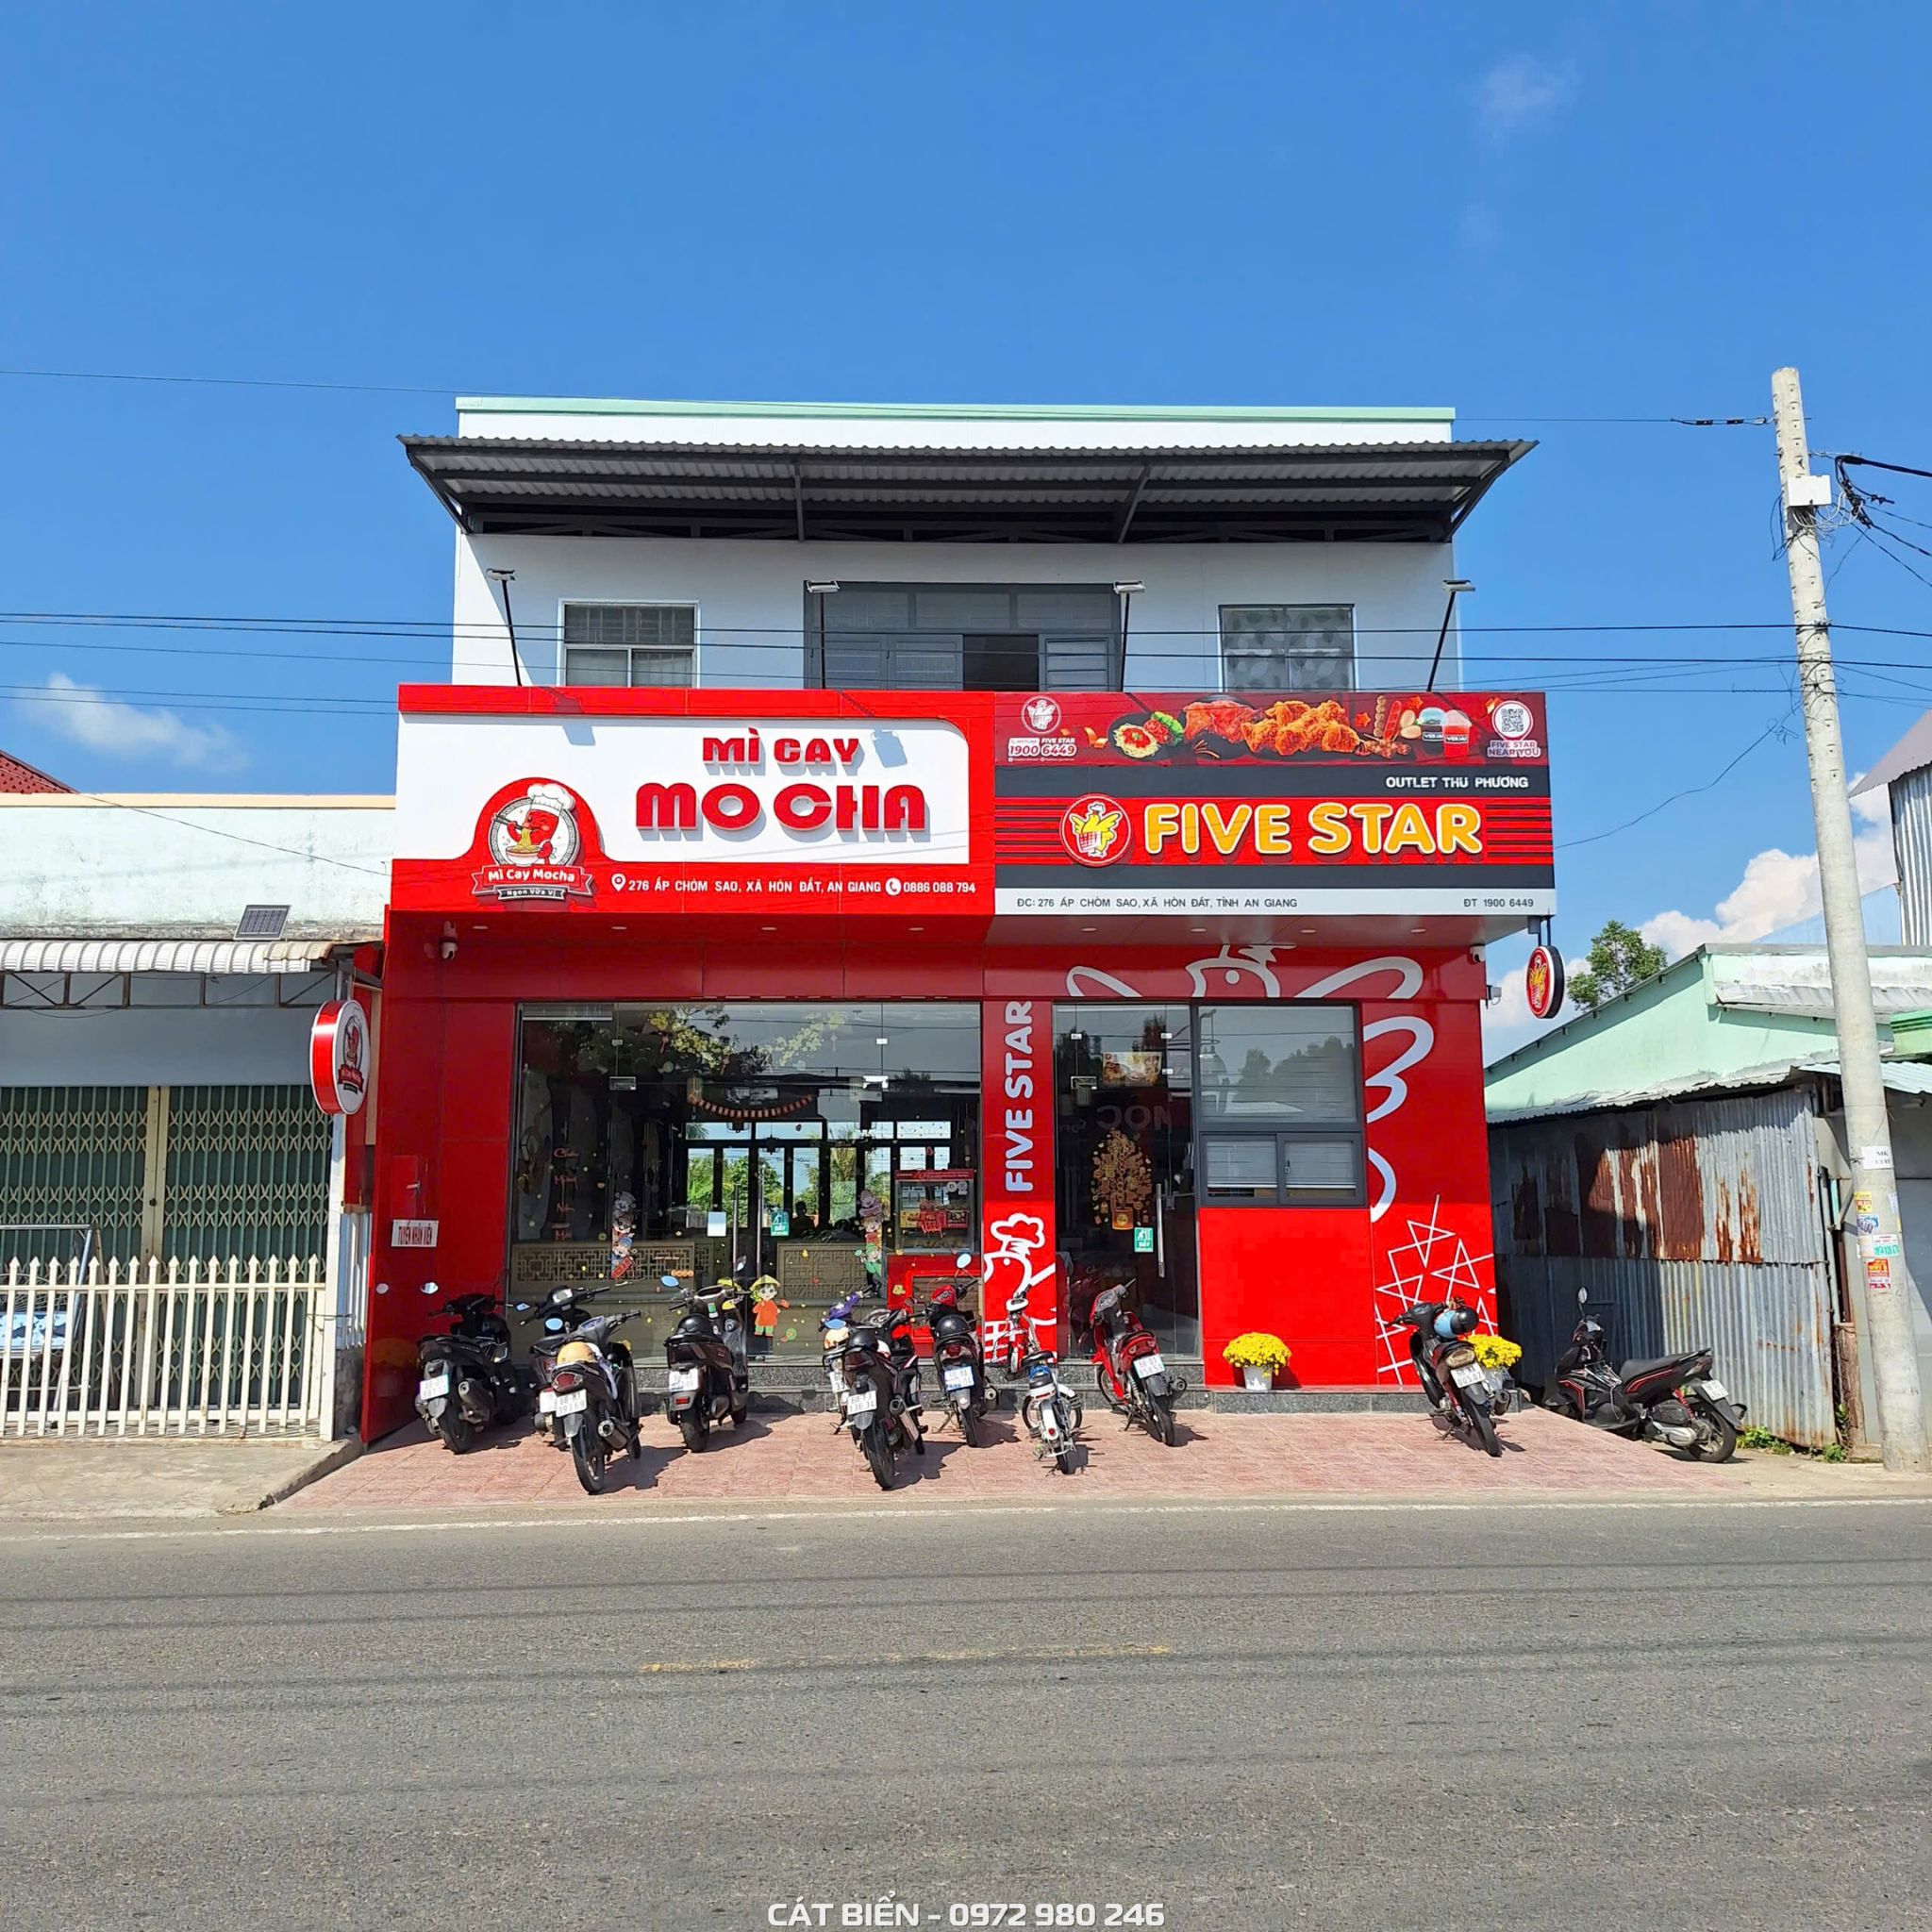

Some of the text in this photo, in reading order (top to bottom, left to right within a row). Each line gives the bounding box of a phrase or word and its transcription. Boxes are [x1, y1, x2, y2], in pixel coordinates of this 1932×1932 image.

[703, 727, 859, 765] MÌ CAY
[1009, 744, 1075, 755] 1900 6449
[1386, 776, 1438, 789] OUTLET
[1474, 774, 1529, 789] PHƯƠNG
[1143, 802, 1484, 855] FIVE STAR
[506, 869, 530, 882] Cay
[532, 868, 575, 882] Mocha
[627, 879, 650, 891] 276
[675, 877, 708, 891] CHÒM
[714, 880, 742, 893] SAO,
[768, 878, 792, 892] HÒN
[826, 881, 842, 892] AN
[847, 881, 882, 892] GIANG
[903, 881, 976, 893] 0886 088 794
[1016, 898, 1036, 908] ĐC:
[1038, 898, 1055, 908] 276
[1079, 895, 1111, 908] CHÒM
[1244, 898, 1259, 908] AN
[1264, 898, 1298, 908] GIANG
[1463, 898, 1534, 908] ĐT 1900 6449
[1004, 1000, 1034, 1192] FIVE STAR
